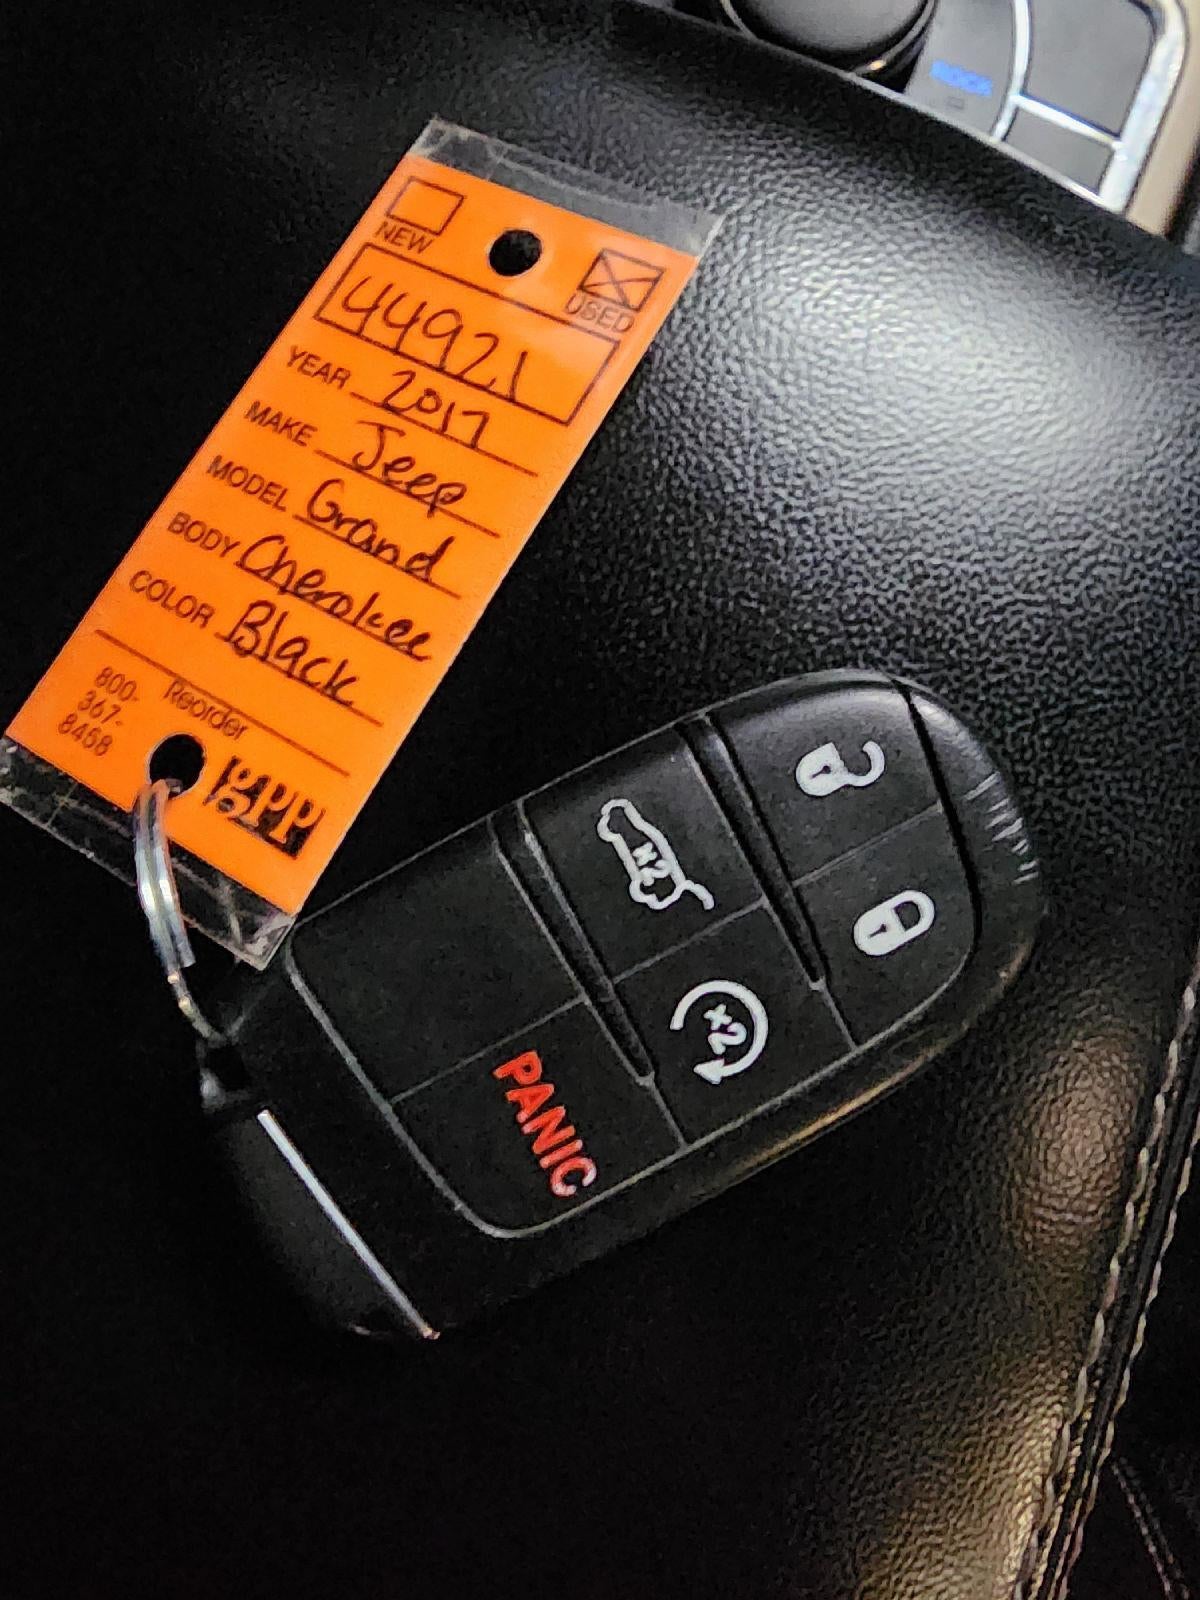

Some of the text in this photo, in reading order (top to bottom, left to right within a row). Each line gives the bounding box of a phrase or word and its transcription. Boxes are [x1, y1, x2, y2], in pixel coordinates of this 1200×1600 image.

[376, 222, 433, 255] NEW
[340, 274, 530, 402] 44921
[564, 294, 635, 335] USED
[287, 345, 351, 391] YEAR
[244, 400, 318, 448] MAKE
[379, 369, 491, 450] 2017
[205, 454, 288, 513] MODEL
[351, 420, 468, 519] Jeep
[166, 511, 242, 559] BODY
[306, 477, 457, 584] Grand
[128, 569, 217, 630] COLOR
[226, 599, 358, 706] Black
[163, 676, 249, 741] Reorder
[492, 1050, 598, 1198] PANIC
